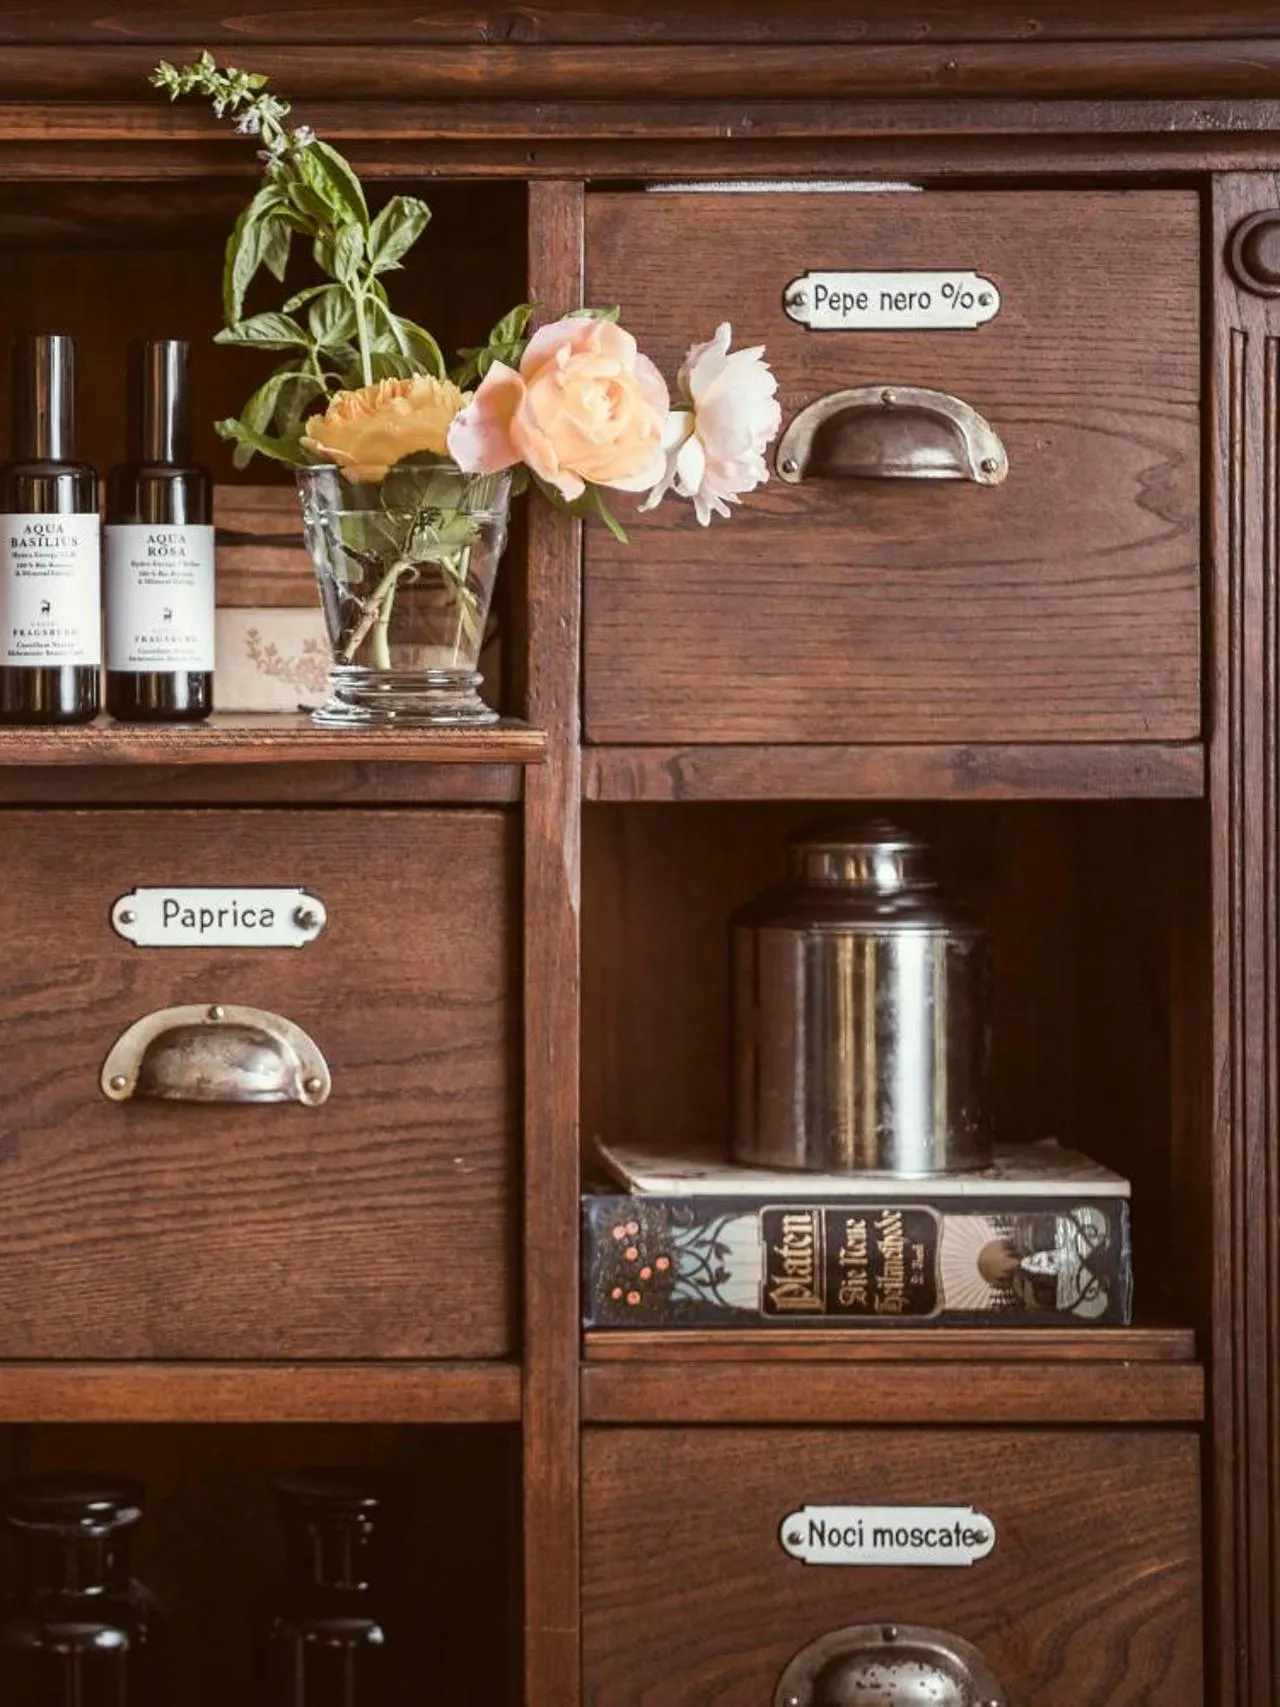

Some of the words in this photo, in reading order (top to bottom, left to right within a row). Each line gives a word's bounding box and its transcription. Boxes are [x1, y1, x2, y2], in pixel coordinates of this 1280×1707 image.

[813, 284, 869, 317] Pepe
[879, 291, 931, 311] nero
[23, 523, 64, 536] AQUA
[11, 536, 79, 548] BASILIUS
[147, 534, 186, 545] AQUA
[147, 547, 186, 557] ROSA
[163, 898, 275, 934] Paprica
[808, 1519, 864, 1548] Noci
[873, 1521, 978, 1548] moscate
